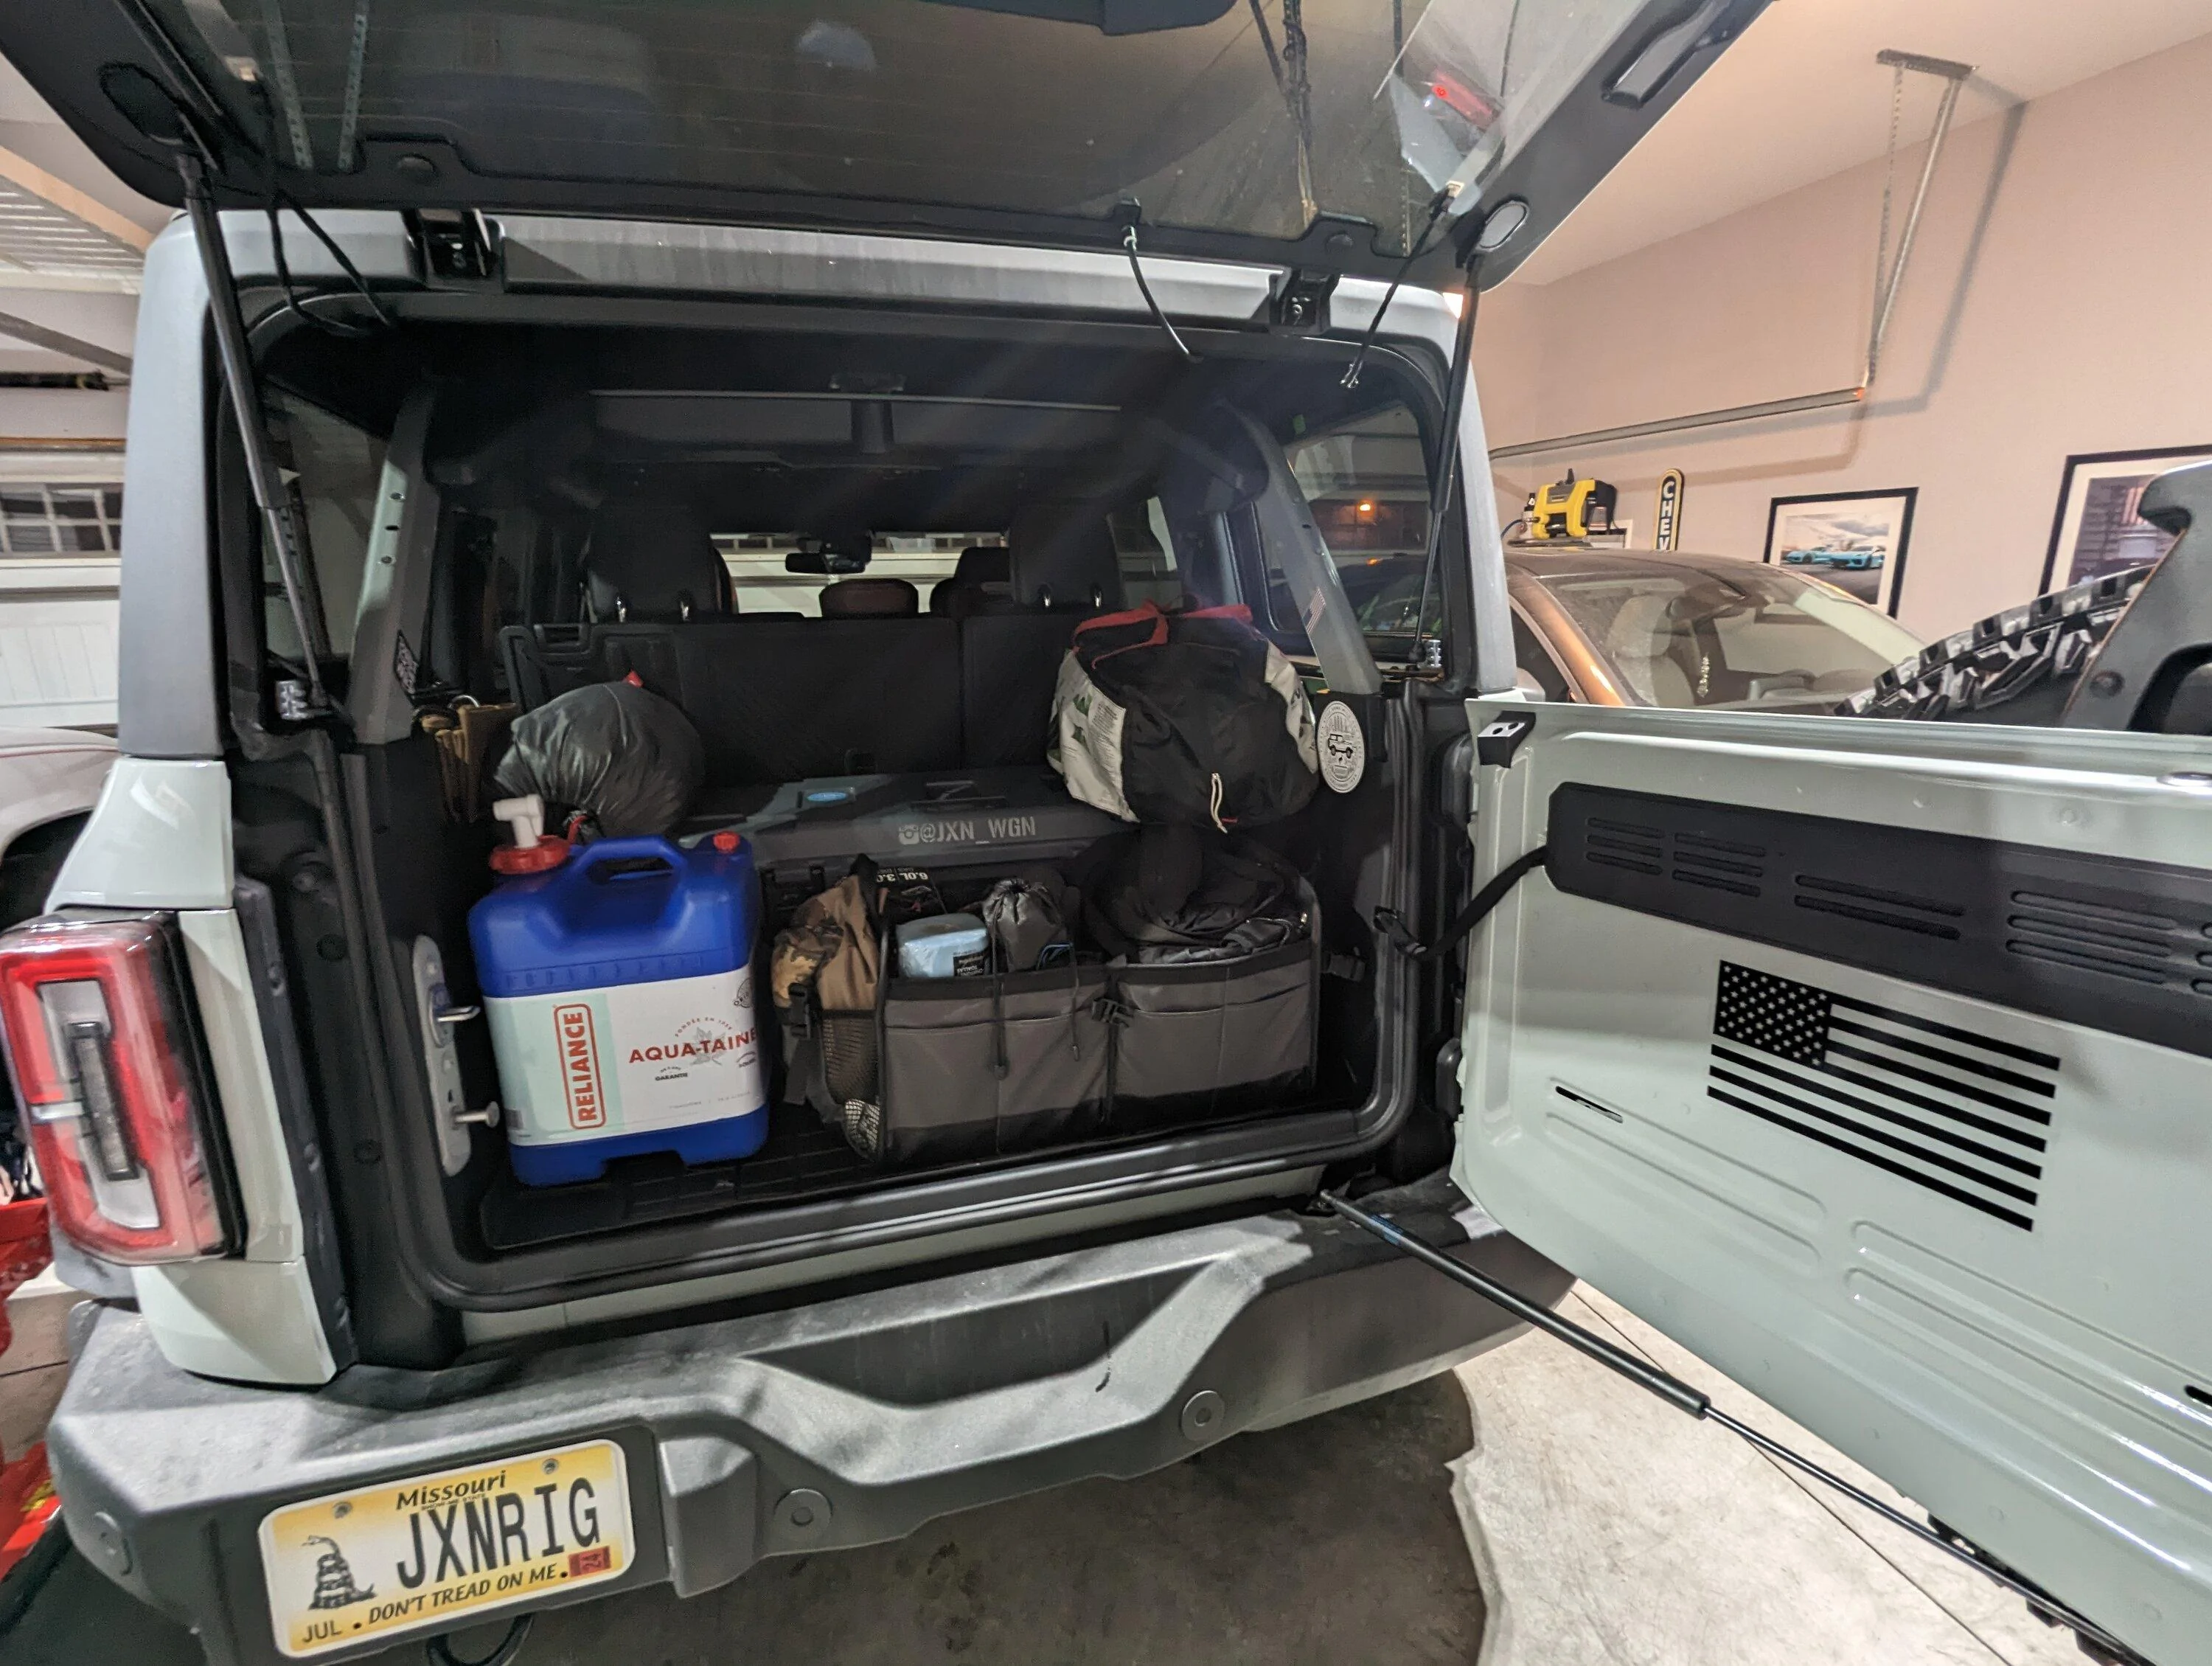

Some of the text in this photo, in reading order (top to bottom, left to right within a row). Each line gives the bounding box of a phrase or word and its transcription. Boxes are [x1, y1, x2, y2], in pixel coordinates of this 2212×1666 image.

[899, 872, 928, 881] 6.0L
[563, 1011, 598, 1122] RELIANCE
[396, 1469, 506, 1510] Missouri
[397, 1477, 601, 1590] JXNRIG
[369, 1563, 557, 1625] DON'T TREAD ON ME
[302, 1620, 342, 1643] JUL
